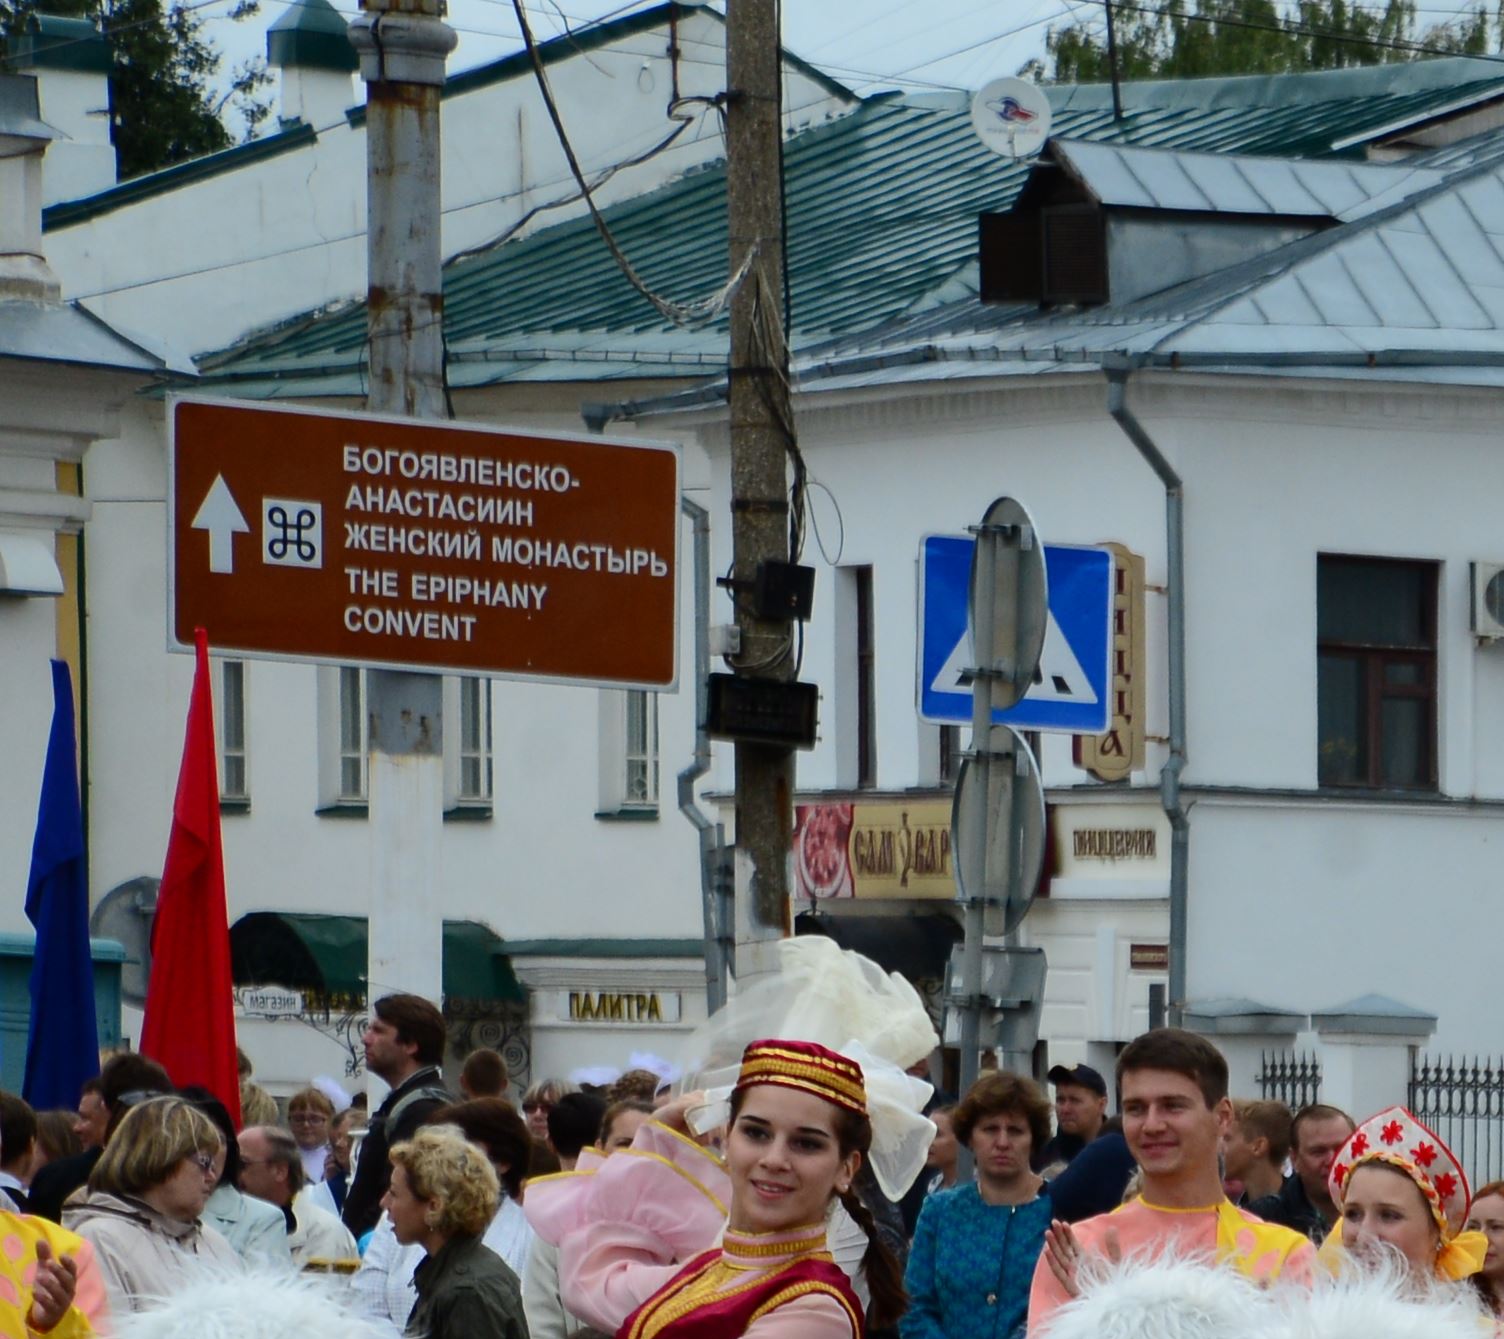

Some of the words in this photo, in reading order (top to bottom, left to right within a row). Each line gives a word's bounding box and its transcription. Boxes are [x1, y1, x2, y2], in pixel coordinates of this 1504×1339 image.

[343, 446, 580, 493] БОГОЯВЛЕНСКО-
[344, 485, 533, 527] АНАСТАСИИН
[344, 523, 481, 560] ЖЕНСКИЙ
[492, 537, 668, 577] МОНАСТЫРЬ
[344, 567, 399, 598] THE
[412, 573, 547, 610] EPIPHANY
[343, 606, 477, 642] CONVENT
[569, 991, 662, 1021] ПАЛИТРА
